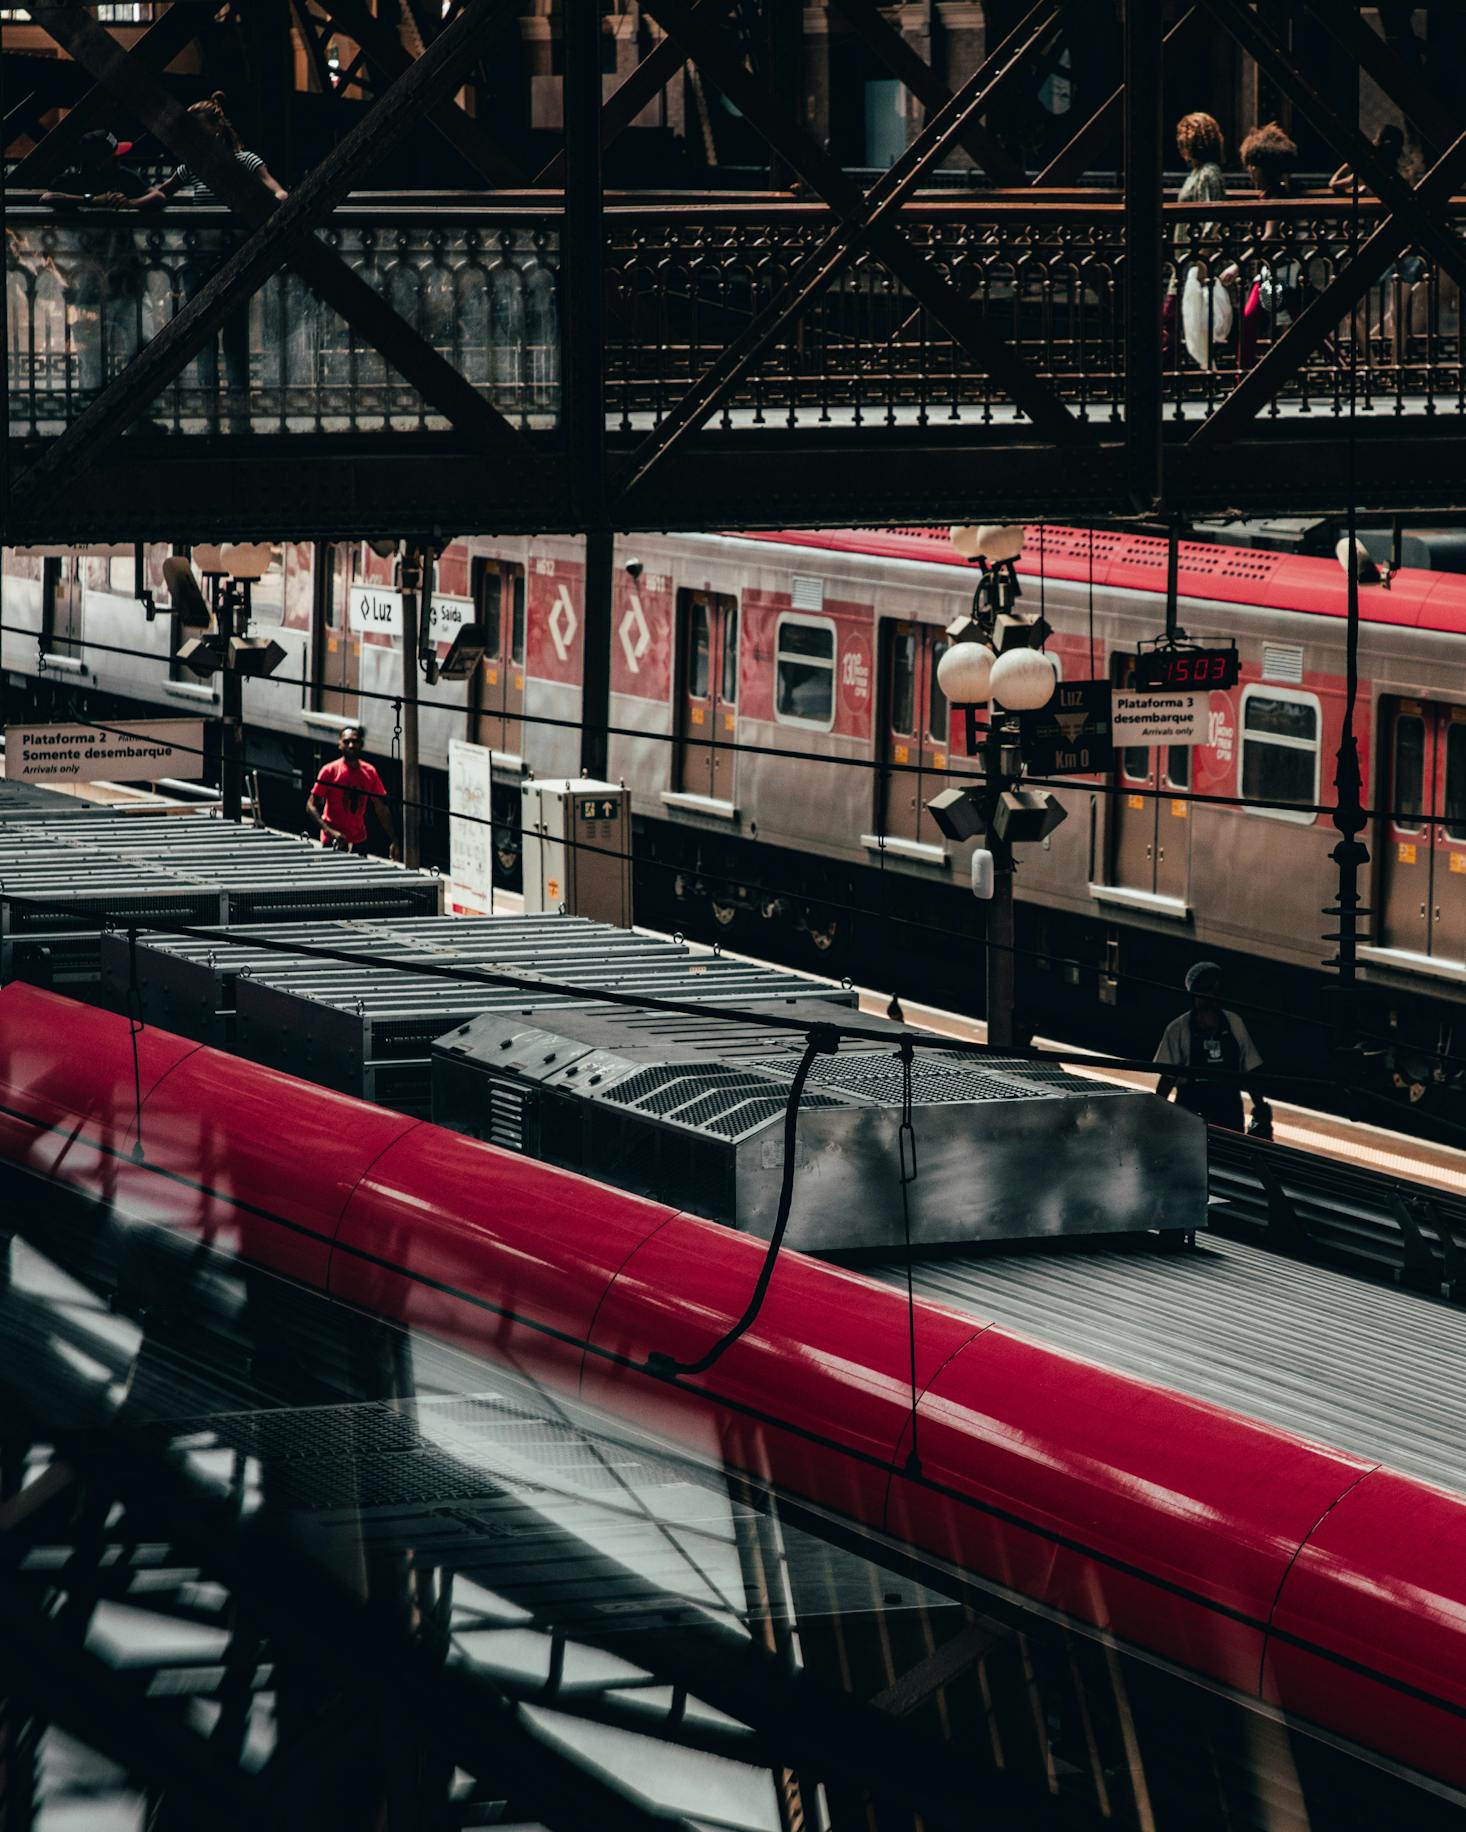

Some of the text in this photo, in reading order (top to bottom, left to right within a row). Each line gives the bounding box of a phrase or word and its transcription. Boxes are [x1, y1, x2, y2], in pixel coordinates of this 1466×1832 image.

[372, 596, 392, 622] Luz
[1060, 689, 1084, 707] Luz
[1117, 697, 1194, 709] Plataforma 3
[1113, 711, 1194, 725] desembarque
[22, 732, 95, 745] Plataforma
[99, 733, 107, 744] 2
[1141, 727, 1194, 737] Arrivals only
[22, 746, 172, 761] Somente desembarque
[1055, 750, 1077, 769] Km
[22, 763, 80, 775] Arrivals only
